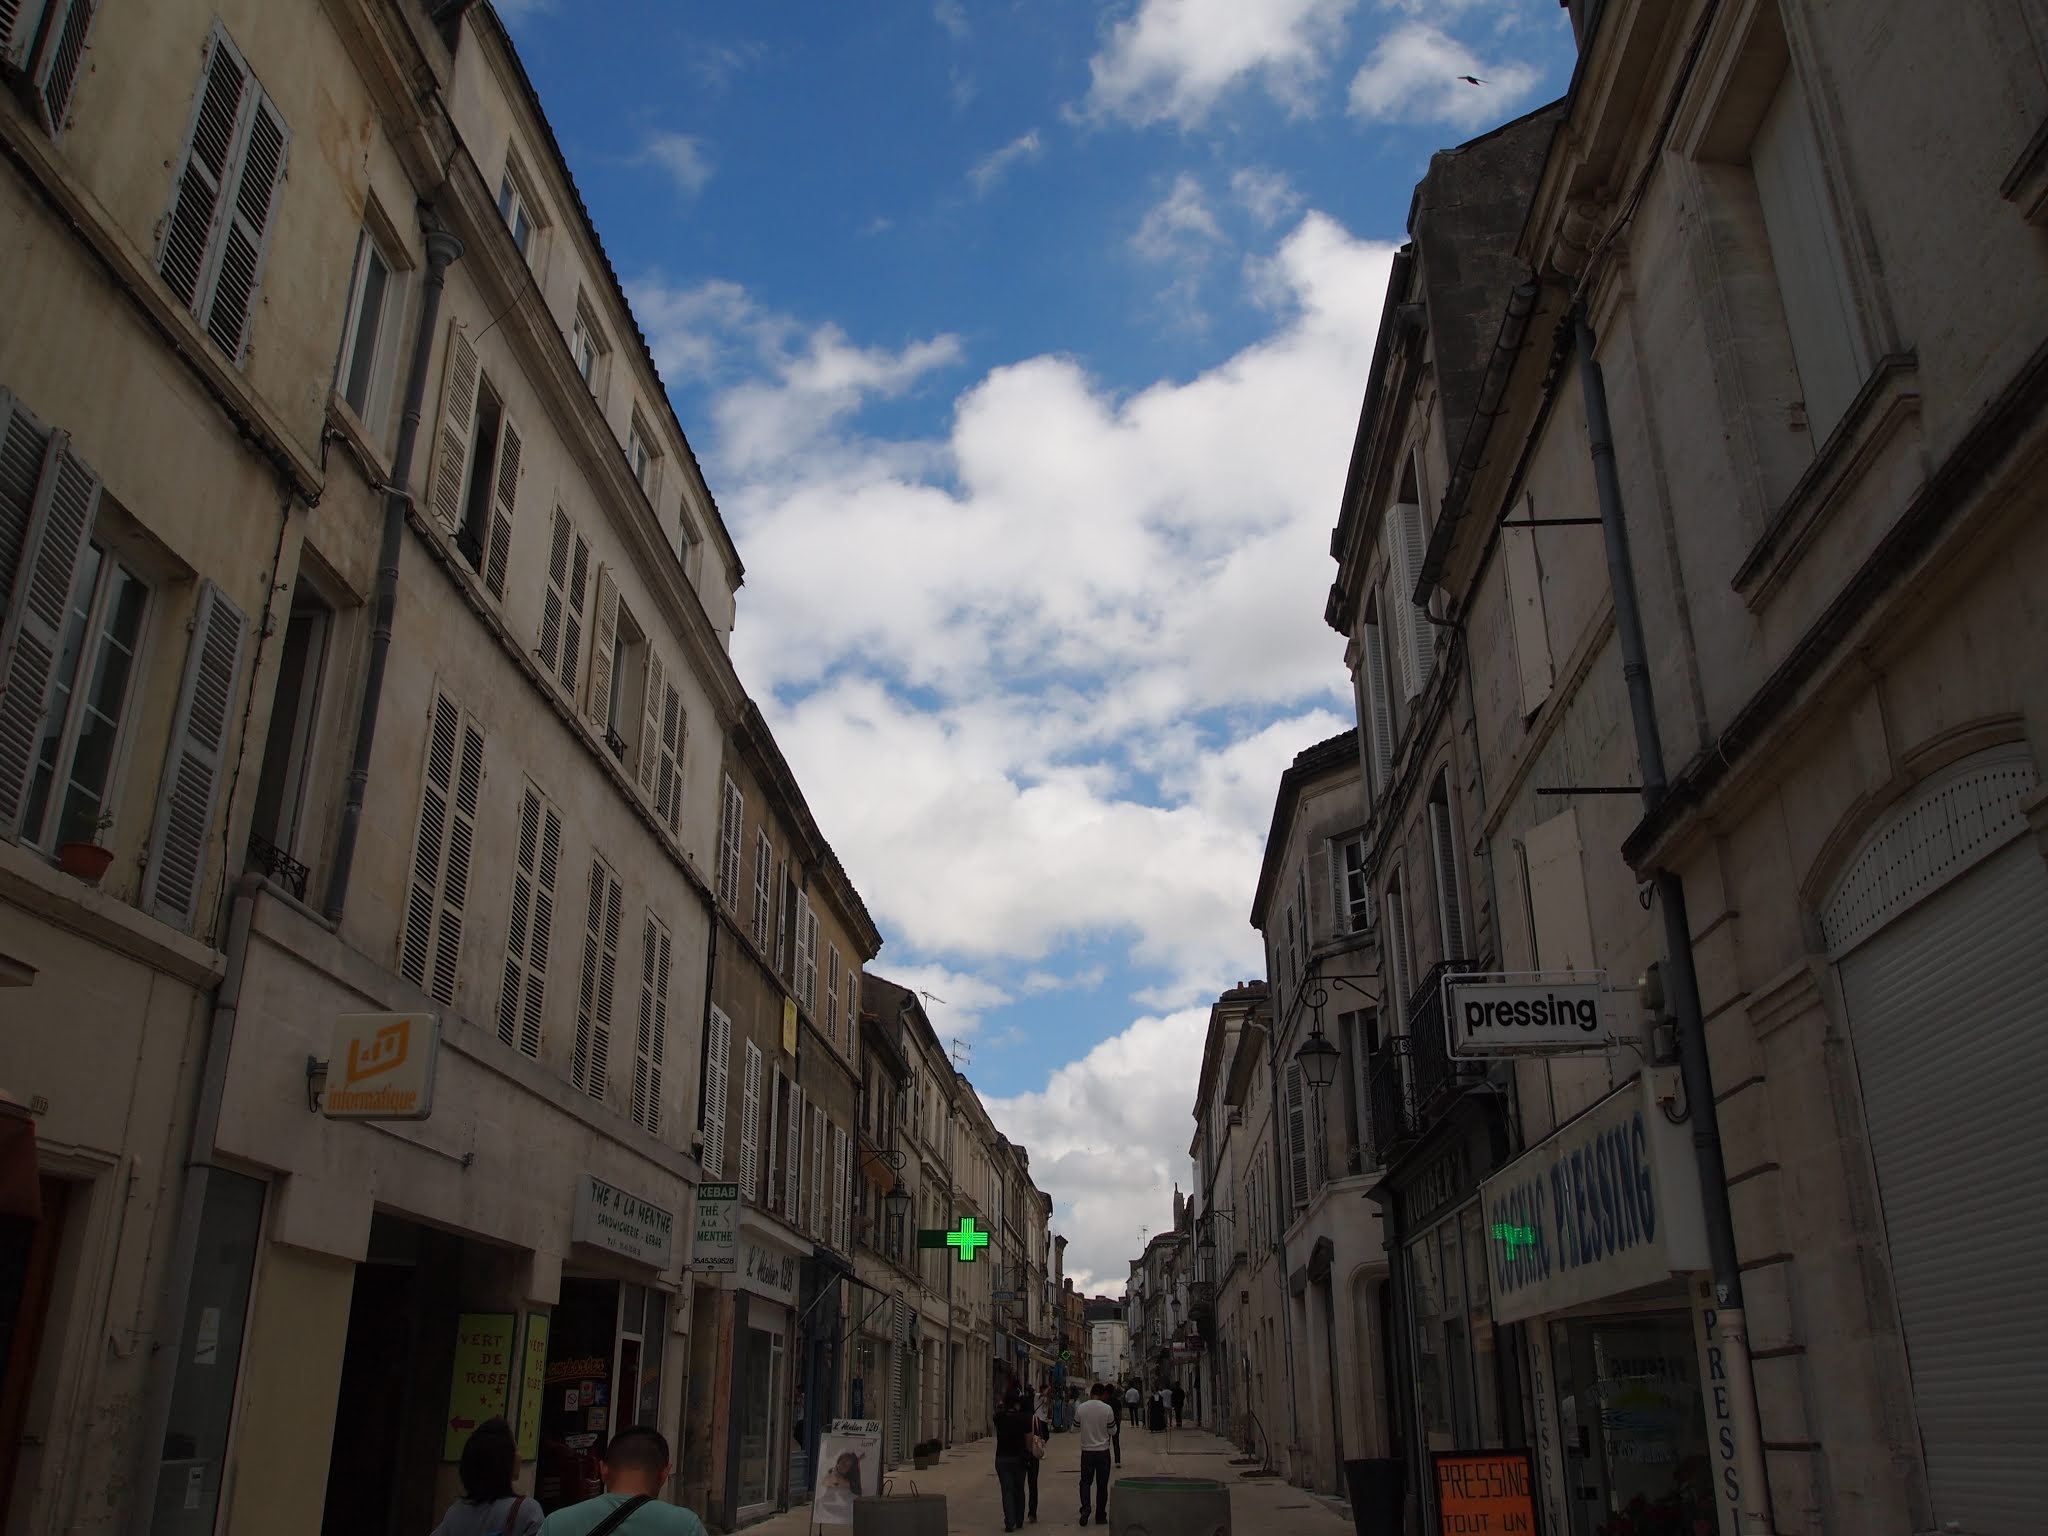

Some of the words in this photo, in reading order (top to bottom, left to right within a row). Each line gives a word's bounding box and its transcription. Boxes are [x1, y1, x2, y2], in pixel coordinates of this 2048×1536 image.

[1465, 993, 1597, 1036] pressing
[328, 1081, 417, 1116] informatique
[700, 1186, 737, 1198] KEBAB
[1550, 1111, 1656, 1273] PRESSING
[591, 1182, 609, 1207] THE
[613, 1193, 620, 1211] A
[624, 1198, 635, 1217] LA
[638, 1204, 672, 1233] MENTHE
[707, 1219, 717, 1227] LA
[597, 1212, 640, 1240] SANDWICHERIE
[645, 1234, 662, 1249] KEBAB
[697, 1231, 733, 1242] MENTHE
[460, 1333, 503, 1347] VERT
[529, 1338, 545, 1353] VERT
[481, 1353, 502, 1365] DE
[535, 1359, 543, 1371] DE
[465, 1372, 507, 1385] ROSE
[527, 1377, 542, 1391] ROSE
[865, 1422, 880, 1432] 126
[1438, 1461, 1530, 1499] PRESSING
[1443, 1513, 1490, 1533] TOUT
[1502, 1514, 1528, 1532] UN
